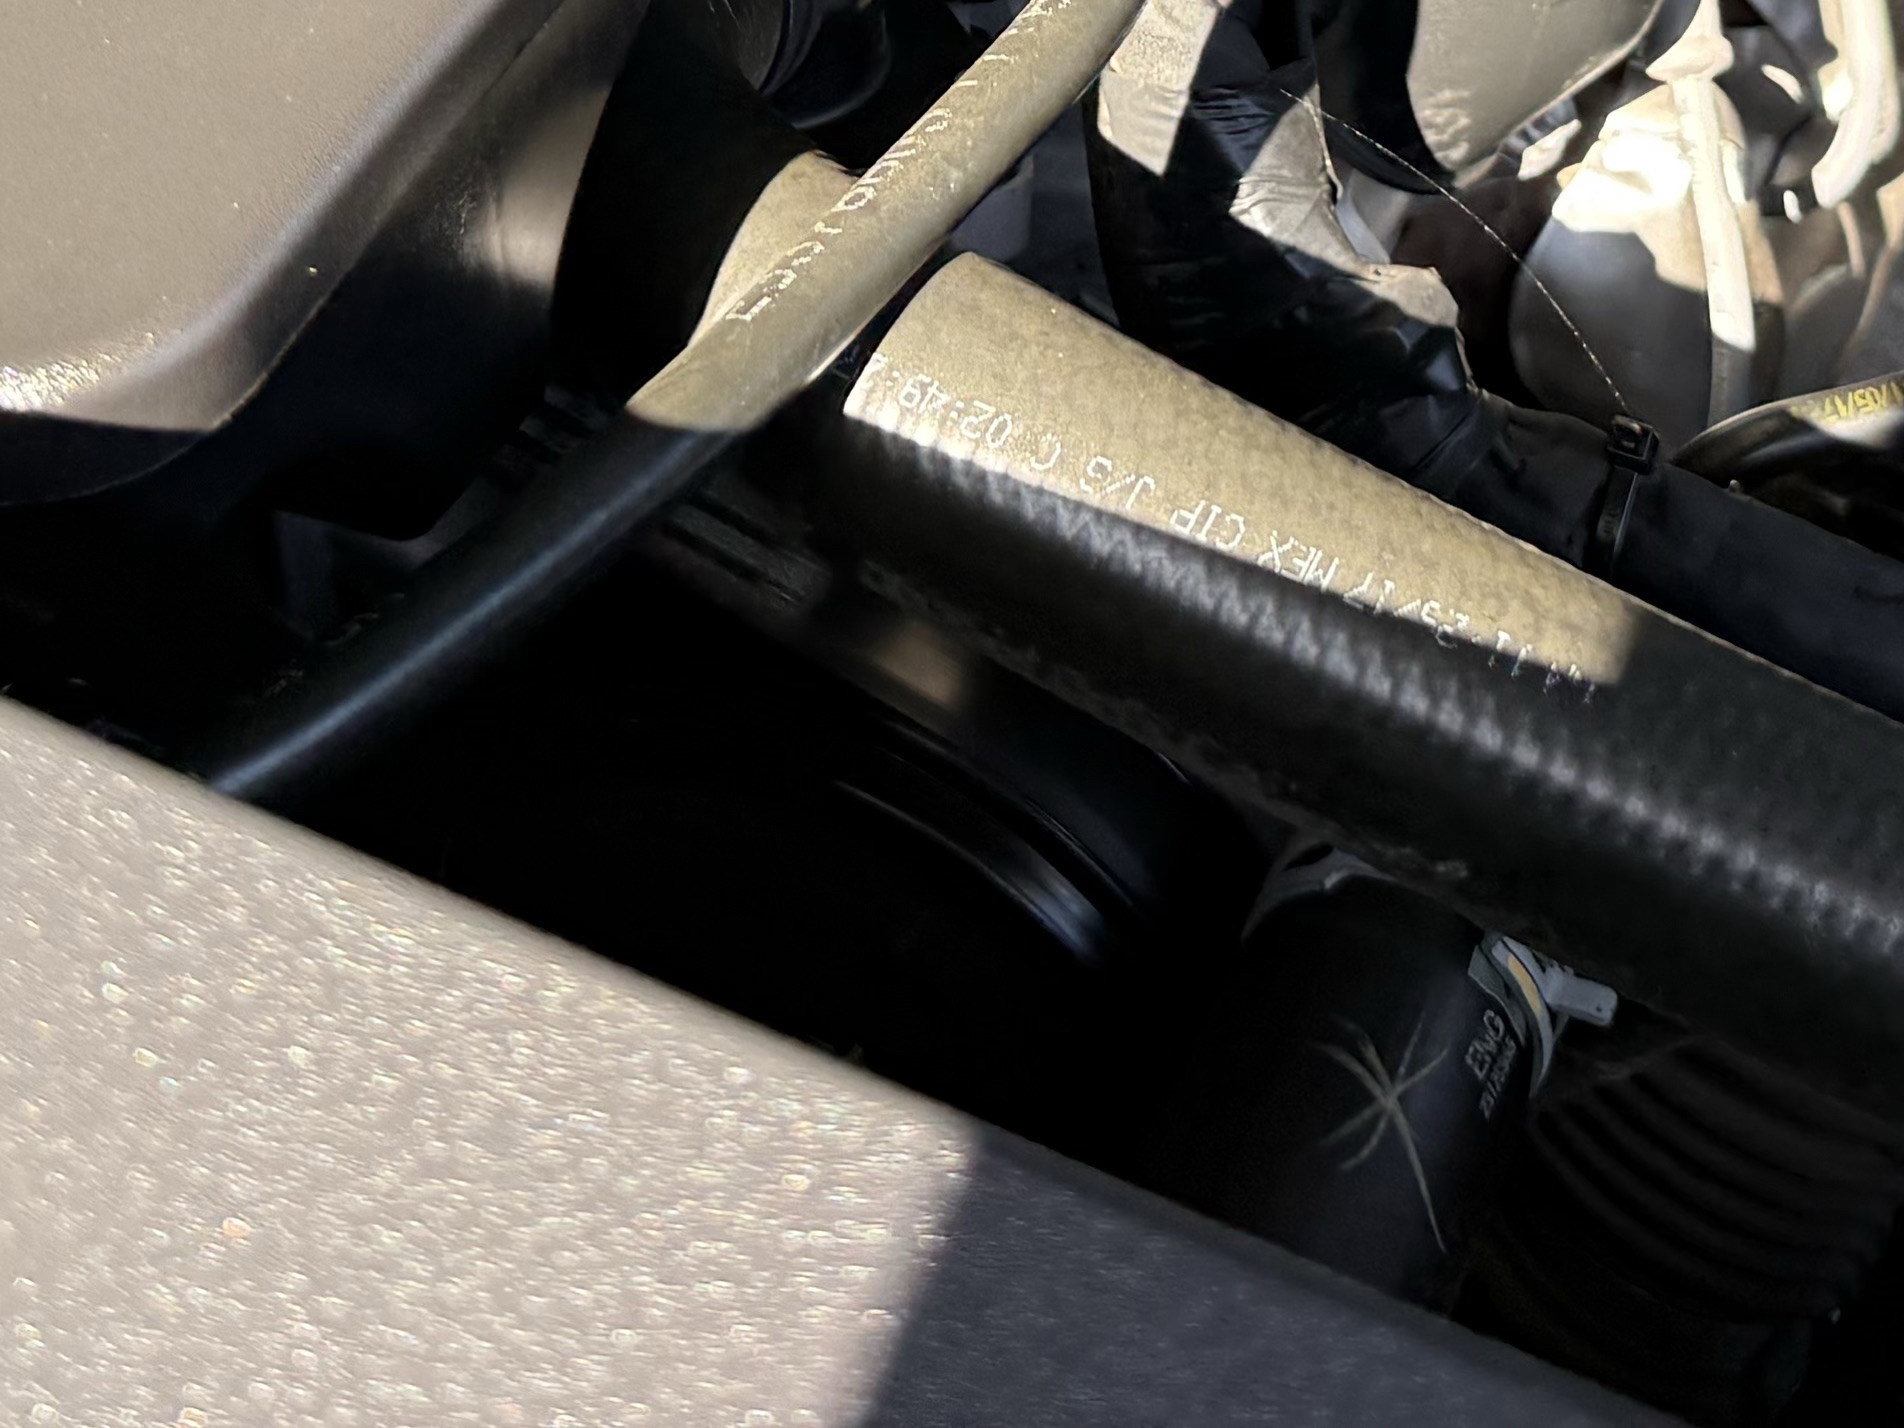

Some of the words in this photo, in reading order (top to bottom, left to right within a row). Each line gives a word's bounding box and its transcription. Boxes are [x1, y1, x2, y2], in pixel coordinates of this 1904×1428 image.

[1169, 497, 1248, 550] CIP
[1258, 529, 1341, 590] MEX
[1463, 1008, 1508, 1079] ENG
